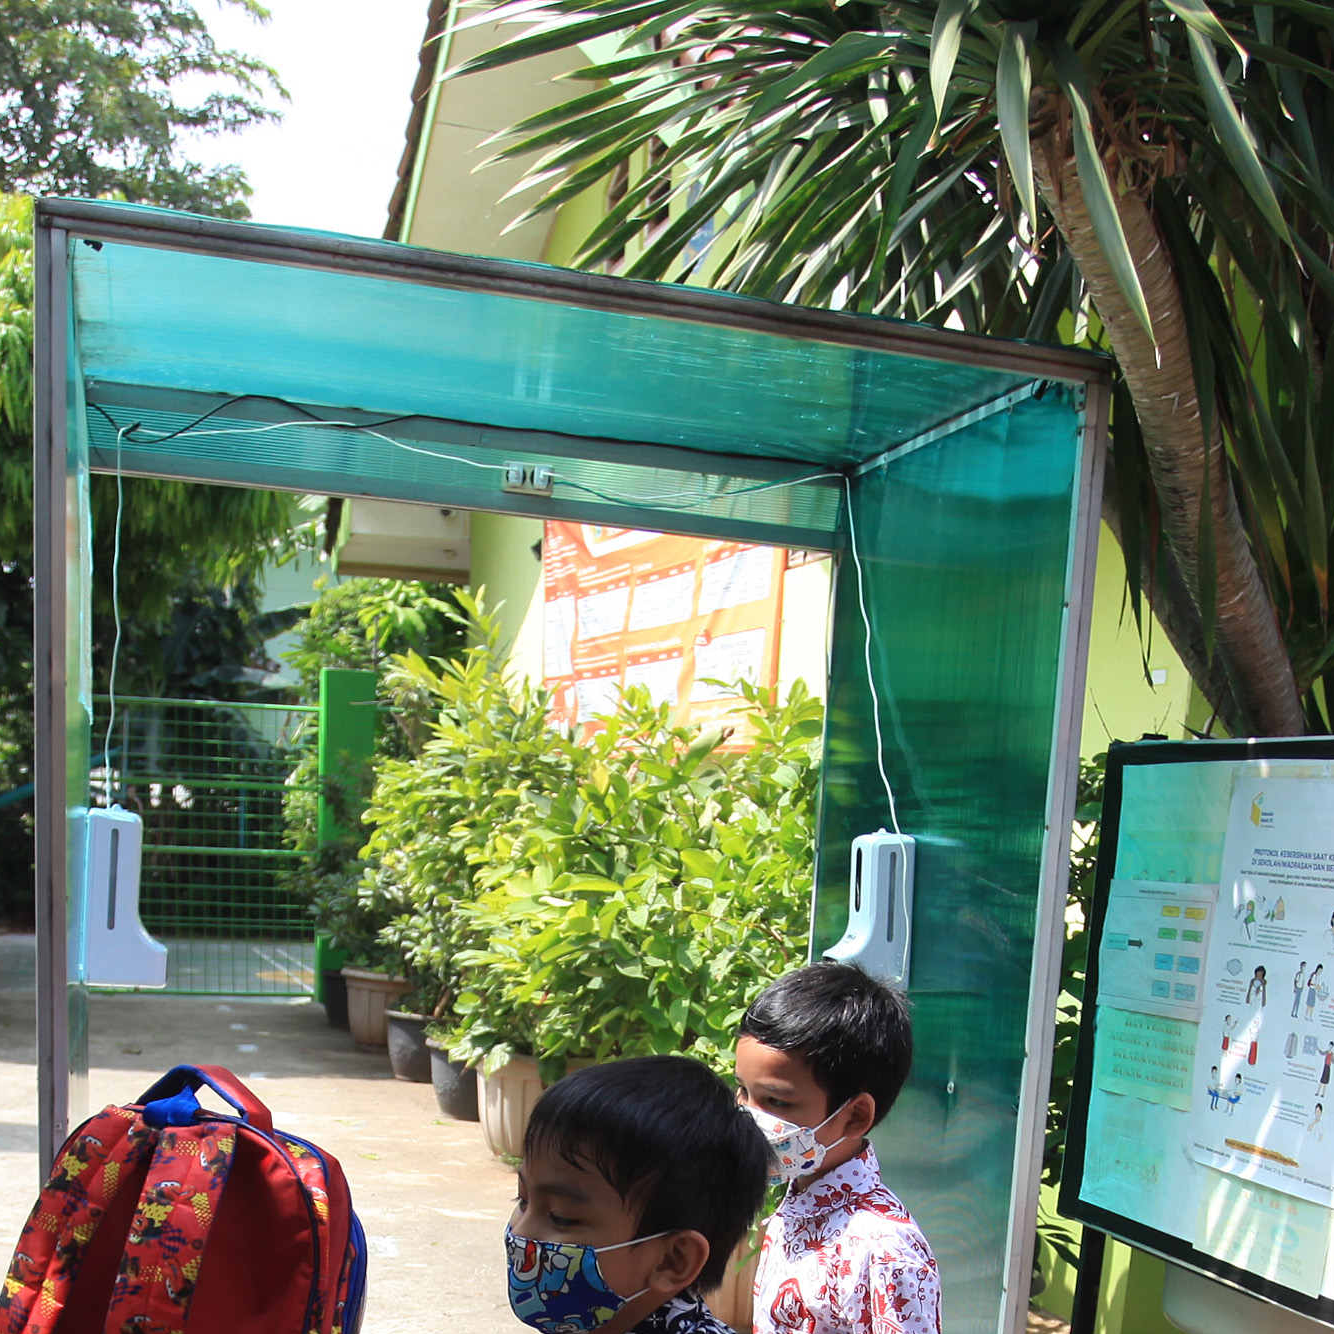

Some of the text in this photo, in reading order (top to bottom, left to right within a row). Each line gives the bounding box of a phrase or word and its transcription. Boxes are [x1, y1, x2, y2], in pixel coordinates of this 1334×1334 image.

[1253, 848, 1279, 858] PROTOKOL
[1280, 850, 1312, 860] KEBERSIHAN
[1313, 852, 1328, 861] SAAT
[1251, 858, 1257, 866] DI
[1313, 863, 1325, 872] DAN
